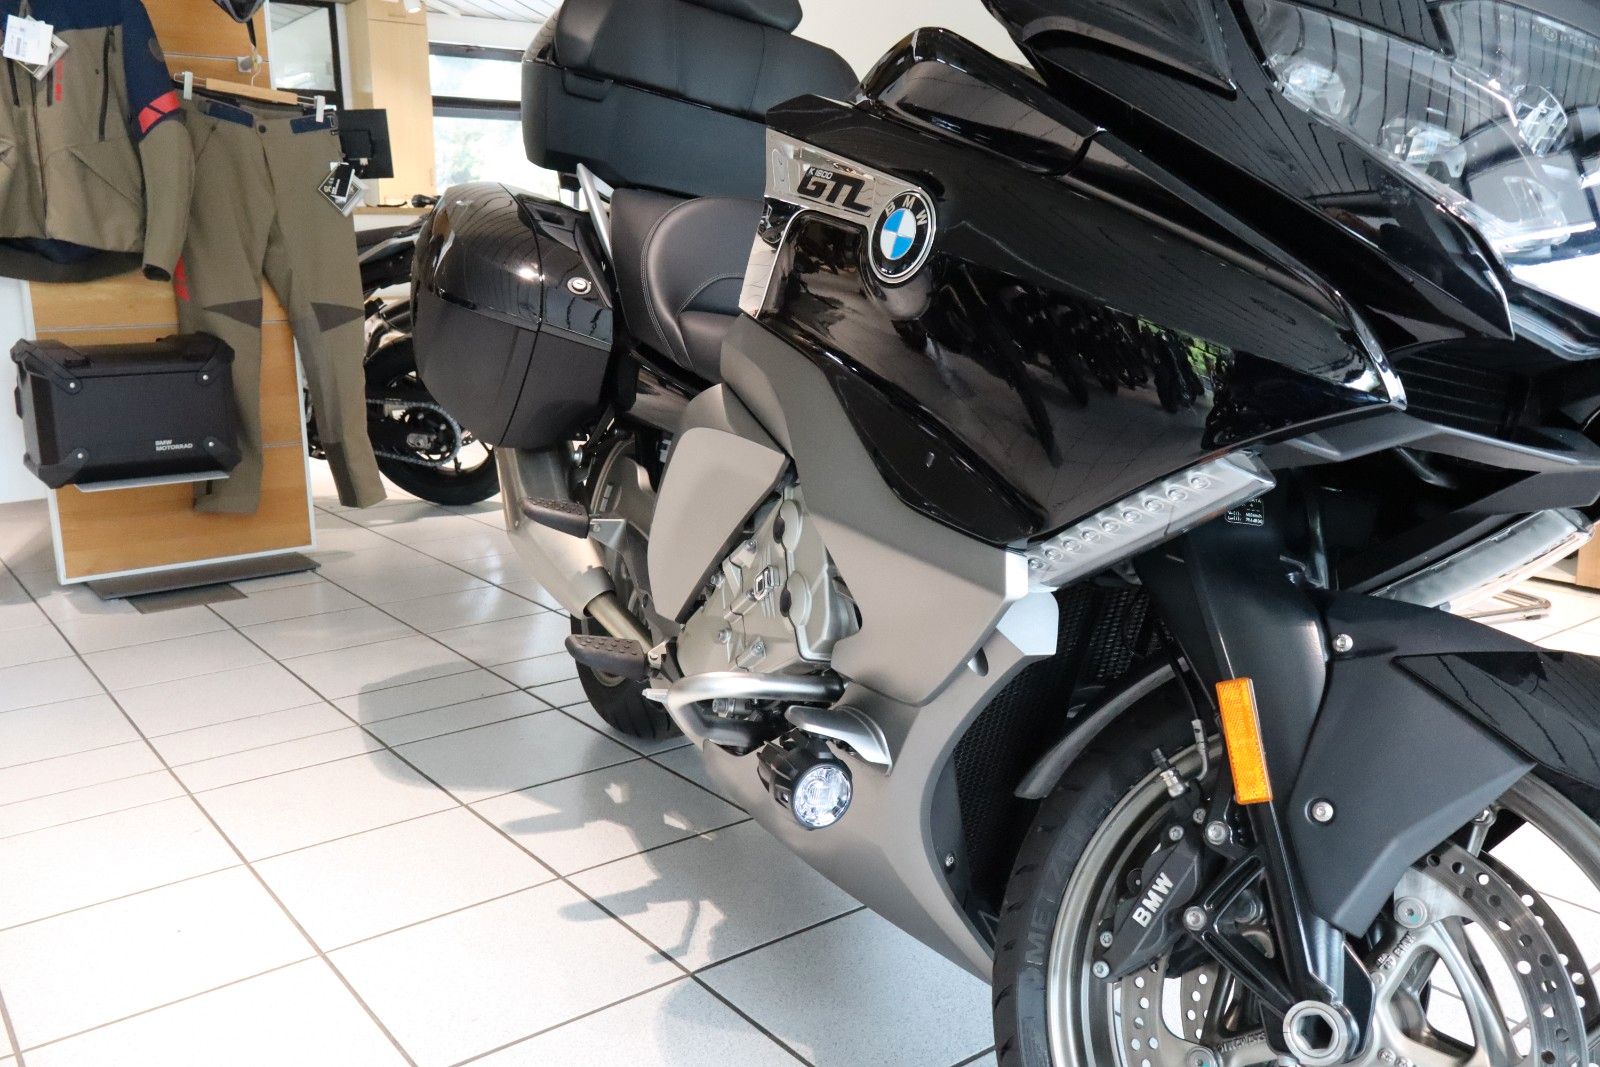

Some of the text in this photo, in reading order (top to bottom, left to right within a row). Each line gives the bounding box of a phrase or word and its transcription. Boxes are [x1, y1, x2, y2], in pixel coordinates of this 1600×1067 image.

[808, 167, 834, 180] K 1600
[797, 167, 872, 213] GTL
[885, 195, 928, 226] BMW
[156, 443, 194, 451] MOTORRAD
[1132, 872, 1174, 928] BMW
